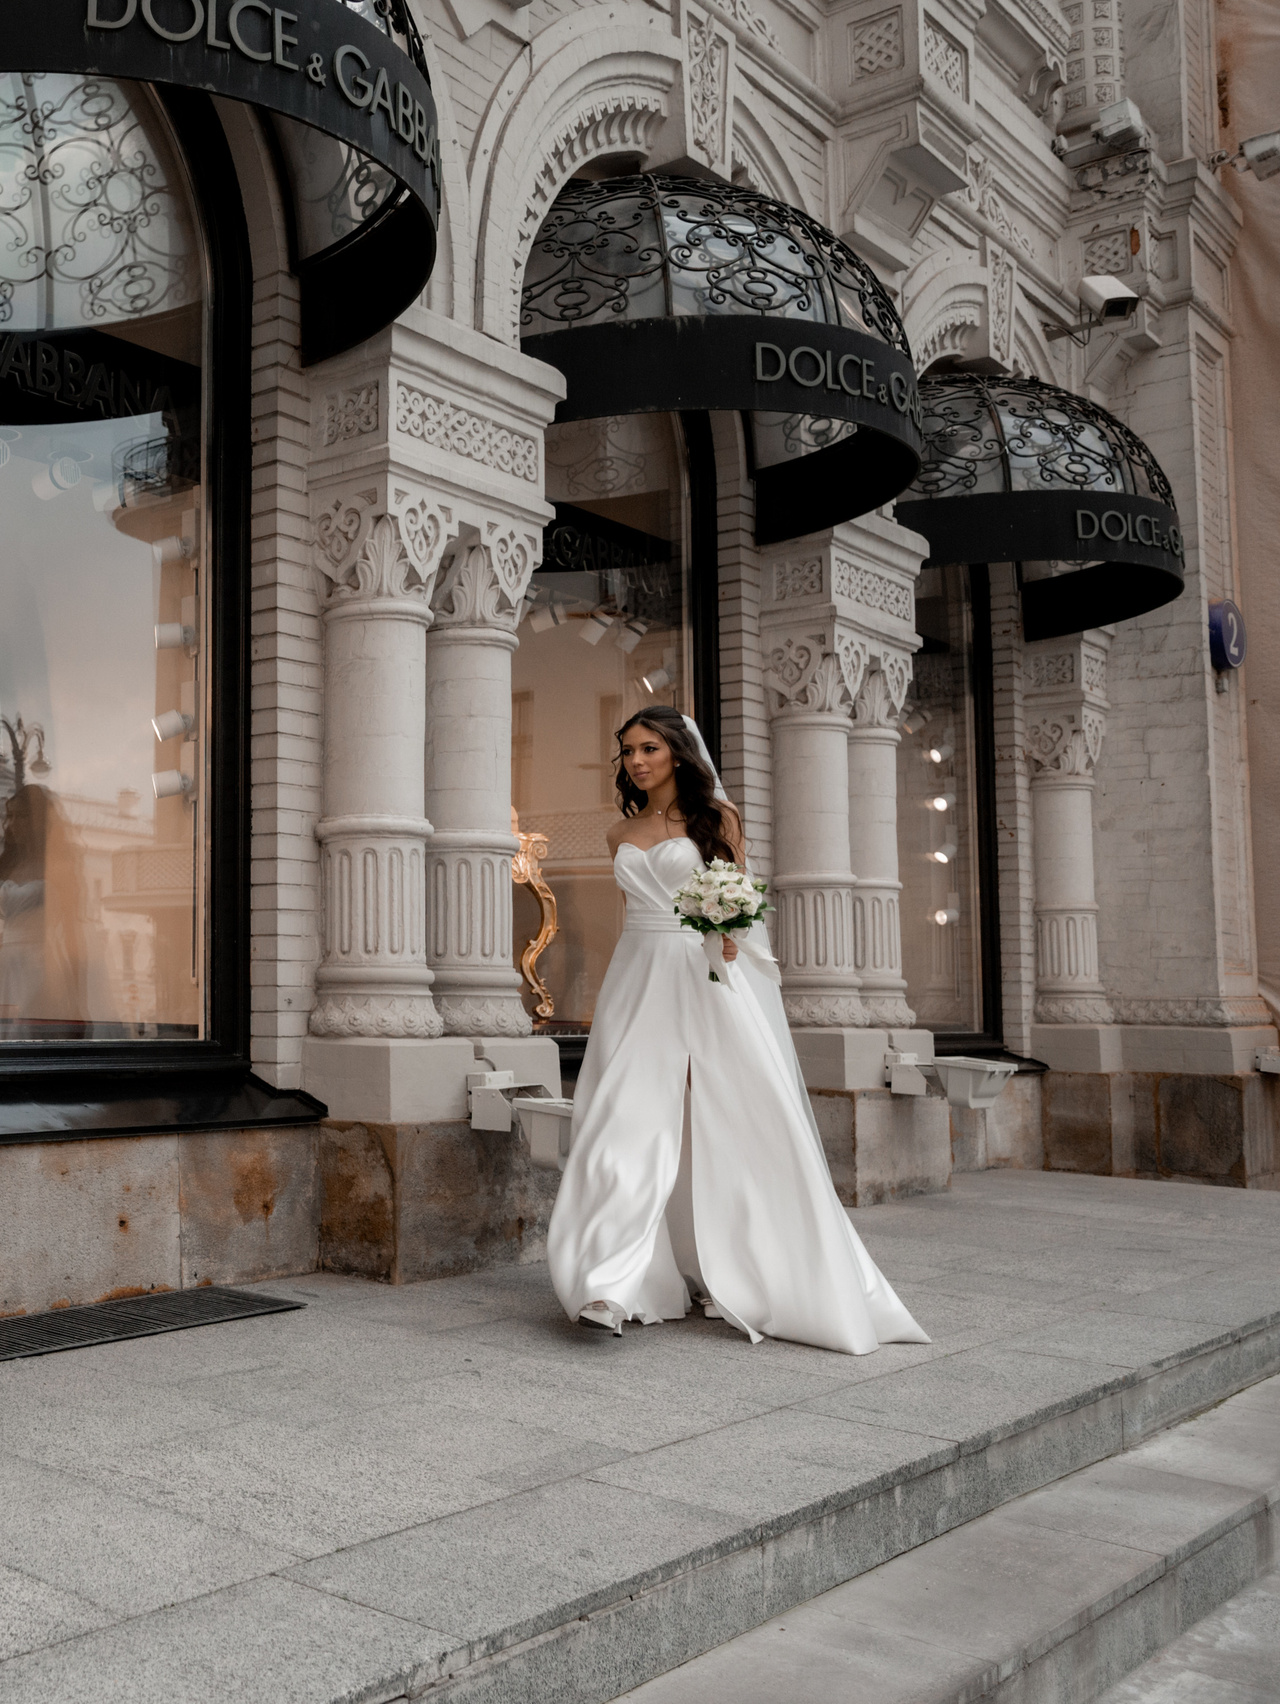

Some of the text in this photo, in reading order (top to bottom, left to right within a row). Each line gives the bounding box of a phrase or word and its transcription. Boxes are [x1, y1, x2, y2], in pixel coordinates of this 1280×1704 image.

[306, 53, 326, 87] &
[334, 44, 441, 200] GABBA
[755, 342, 875, 399] DOLCE
[878, 383, 888, 405] &
[1077, 510, 1161, 546] DOLCE
[1227, 612, 1239, 657] 2
